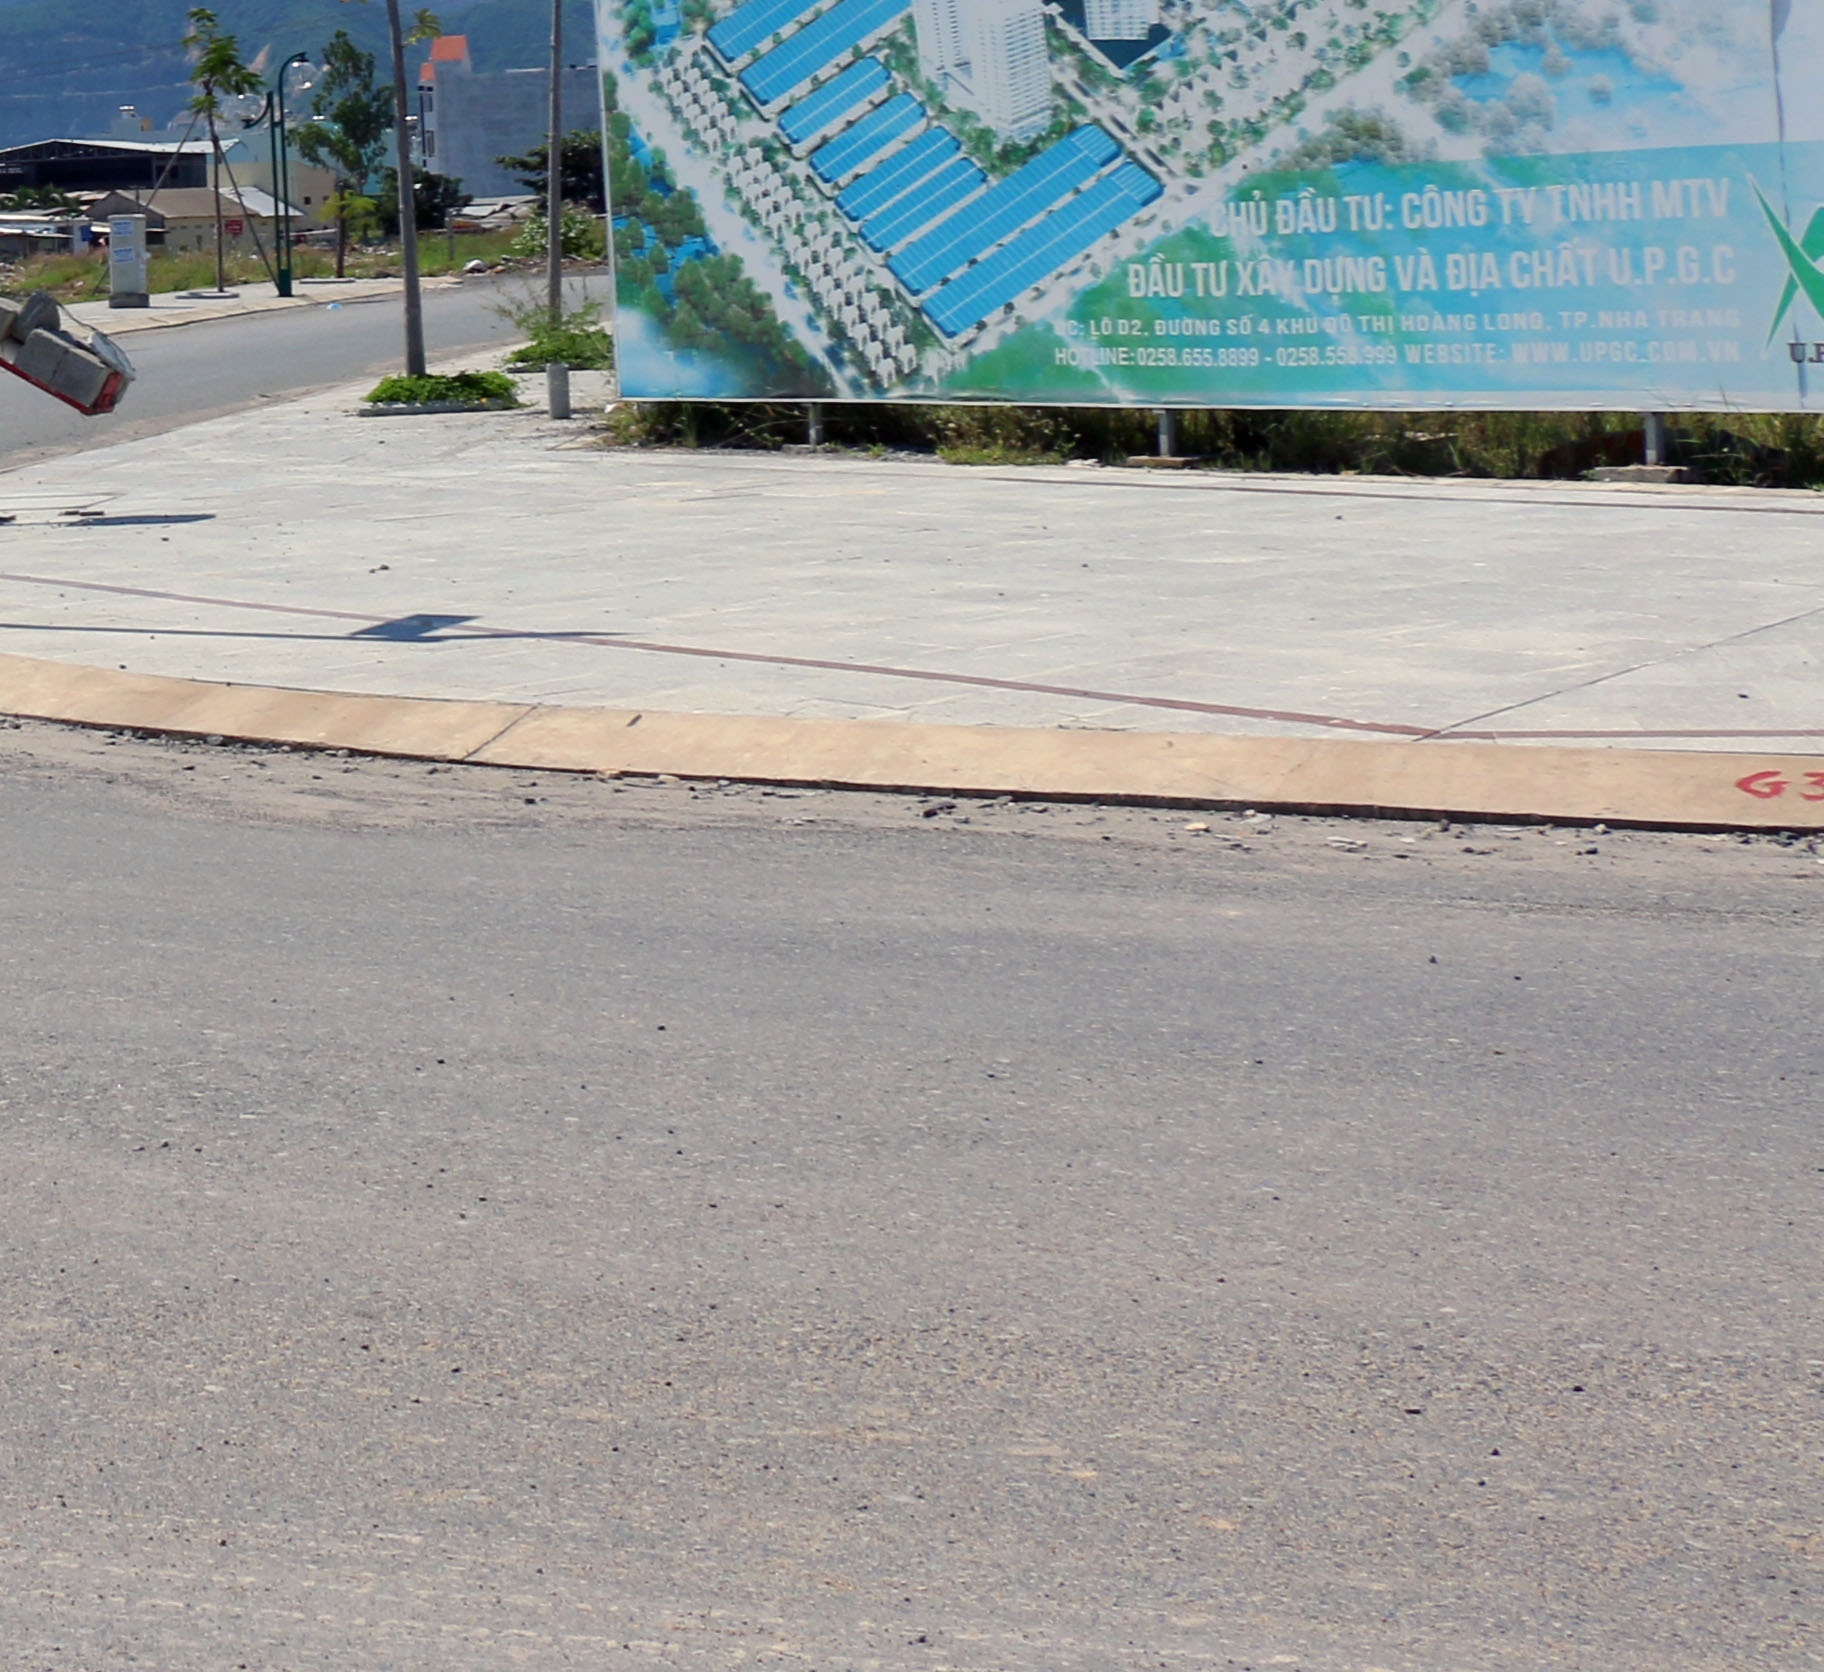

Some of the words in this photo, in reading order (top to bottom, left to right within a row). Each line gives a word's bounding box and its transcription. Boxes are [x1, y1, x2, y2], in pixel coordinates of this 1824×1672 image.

[1211, 190, 1267, 238] CHỦ
[1275, 186, 1336, 234] ĐẦU
[1343, 192, 1394, 231] TƯ:
[1403, 184, 1488, 229] CÔNG
[1497, 188, 1537, 224] TY
[1548, 181, 1642, 223] TNHH
[1652, 177, 1729, 219] MTV
[1127, 252, 1184, 297] ĐẦU
[1191, 260, 1228, 296] TƯ
[1304, 254, 1387, 305] DỰNG
[1394, 247, 1439, 292] VÀ
[1446, 250, 1502, 297] ĐỊA
[1510, 236, 1599, 289] CHẤT
[1609, 244, 1737, 286] U.P.G.C
[1226, 313, 1254, 336] SỐ
[1257, 319, 1271, 334] 4
[1276, 317, 1319, 335] KHU
[1358, 315, 1394, 336] THỊ
[1402, 312, 1477, 331] HOÀNG
[1404, 343, 1505, 365] WEBSITE:
